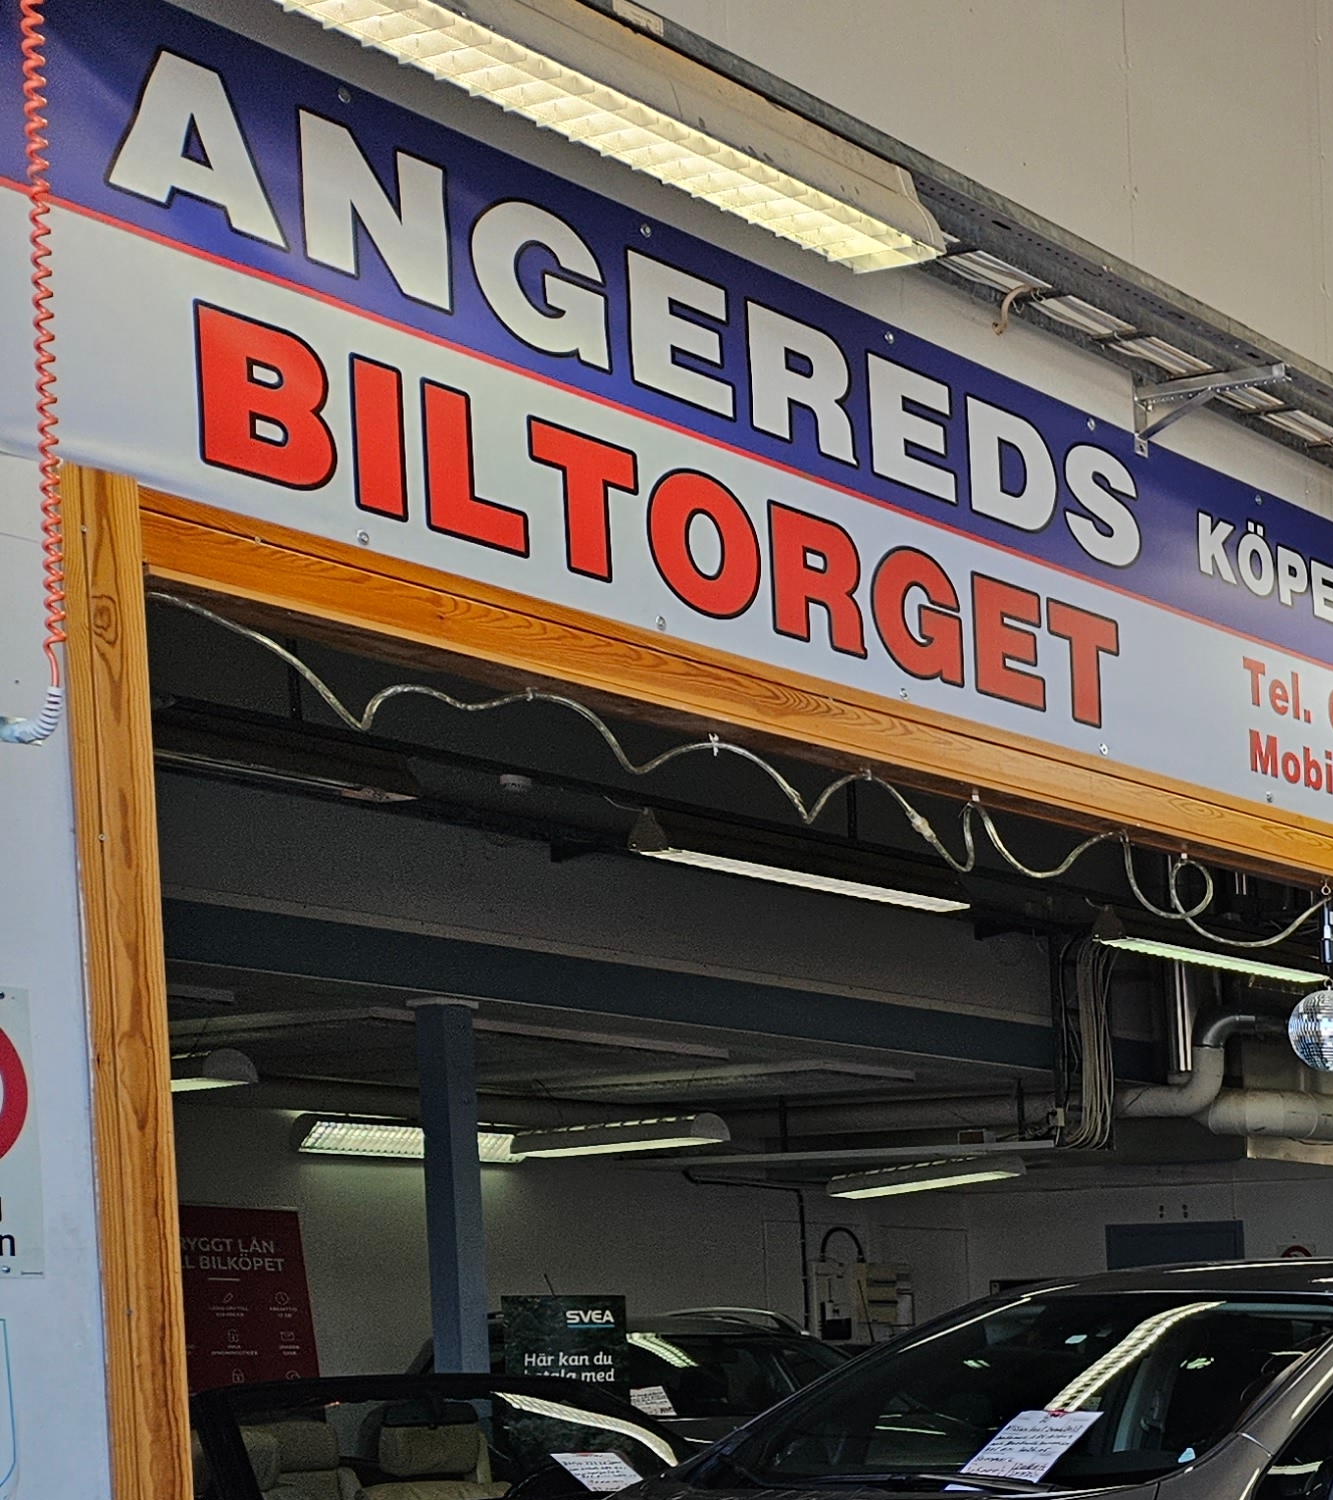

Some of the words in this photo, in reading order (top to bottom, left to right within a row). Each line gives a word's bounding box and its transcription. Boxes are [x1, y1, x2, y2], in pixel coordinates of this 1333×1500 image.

[104, 45, 1142, 568] ANGEREDS
[193, 299, 1119, 727] BILTORGET
[1242, 656, 1312, 724] Tel.
[238, 1236, 275, 1254] LÅN
[200, 1253, 285, 1272] BILKÖPET
[566, 1310, 615, 1323] SVEA
[524, 1353, 555, 1367] Här
[558, 1351, 590, 1367] kan
[593, 1351, 614, 1366] du
[581, 1368, 616, 1383] med
